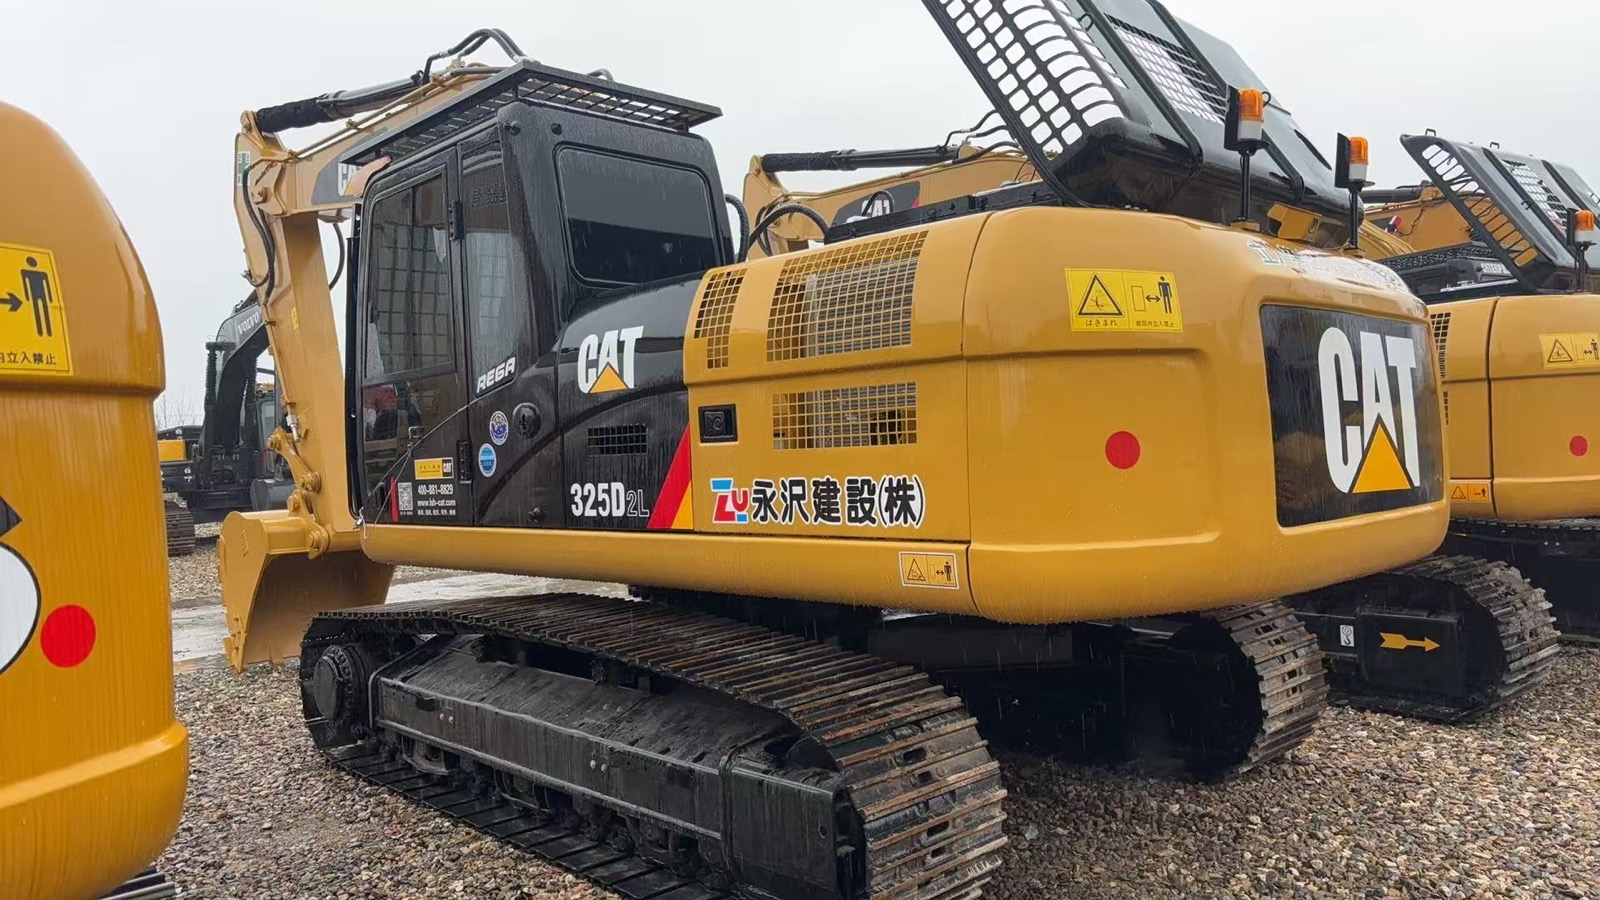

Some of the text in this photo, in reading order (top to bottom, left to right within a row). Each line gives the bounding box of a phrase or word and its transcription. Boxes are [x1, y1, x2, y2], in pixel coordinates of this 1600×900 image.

[238, 311, 260, 334] VOLVO
[577, 325, 644, 394] CAT
[1317, 326, 1421, 494] CAT
[751, 475, 925, 529] 永沢建設(株)
